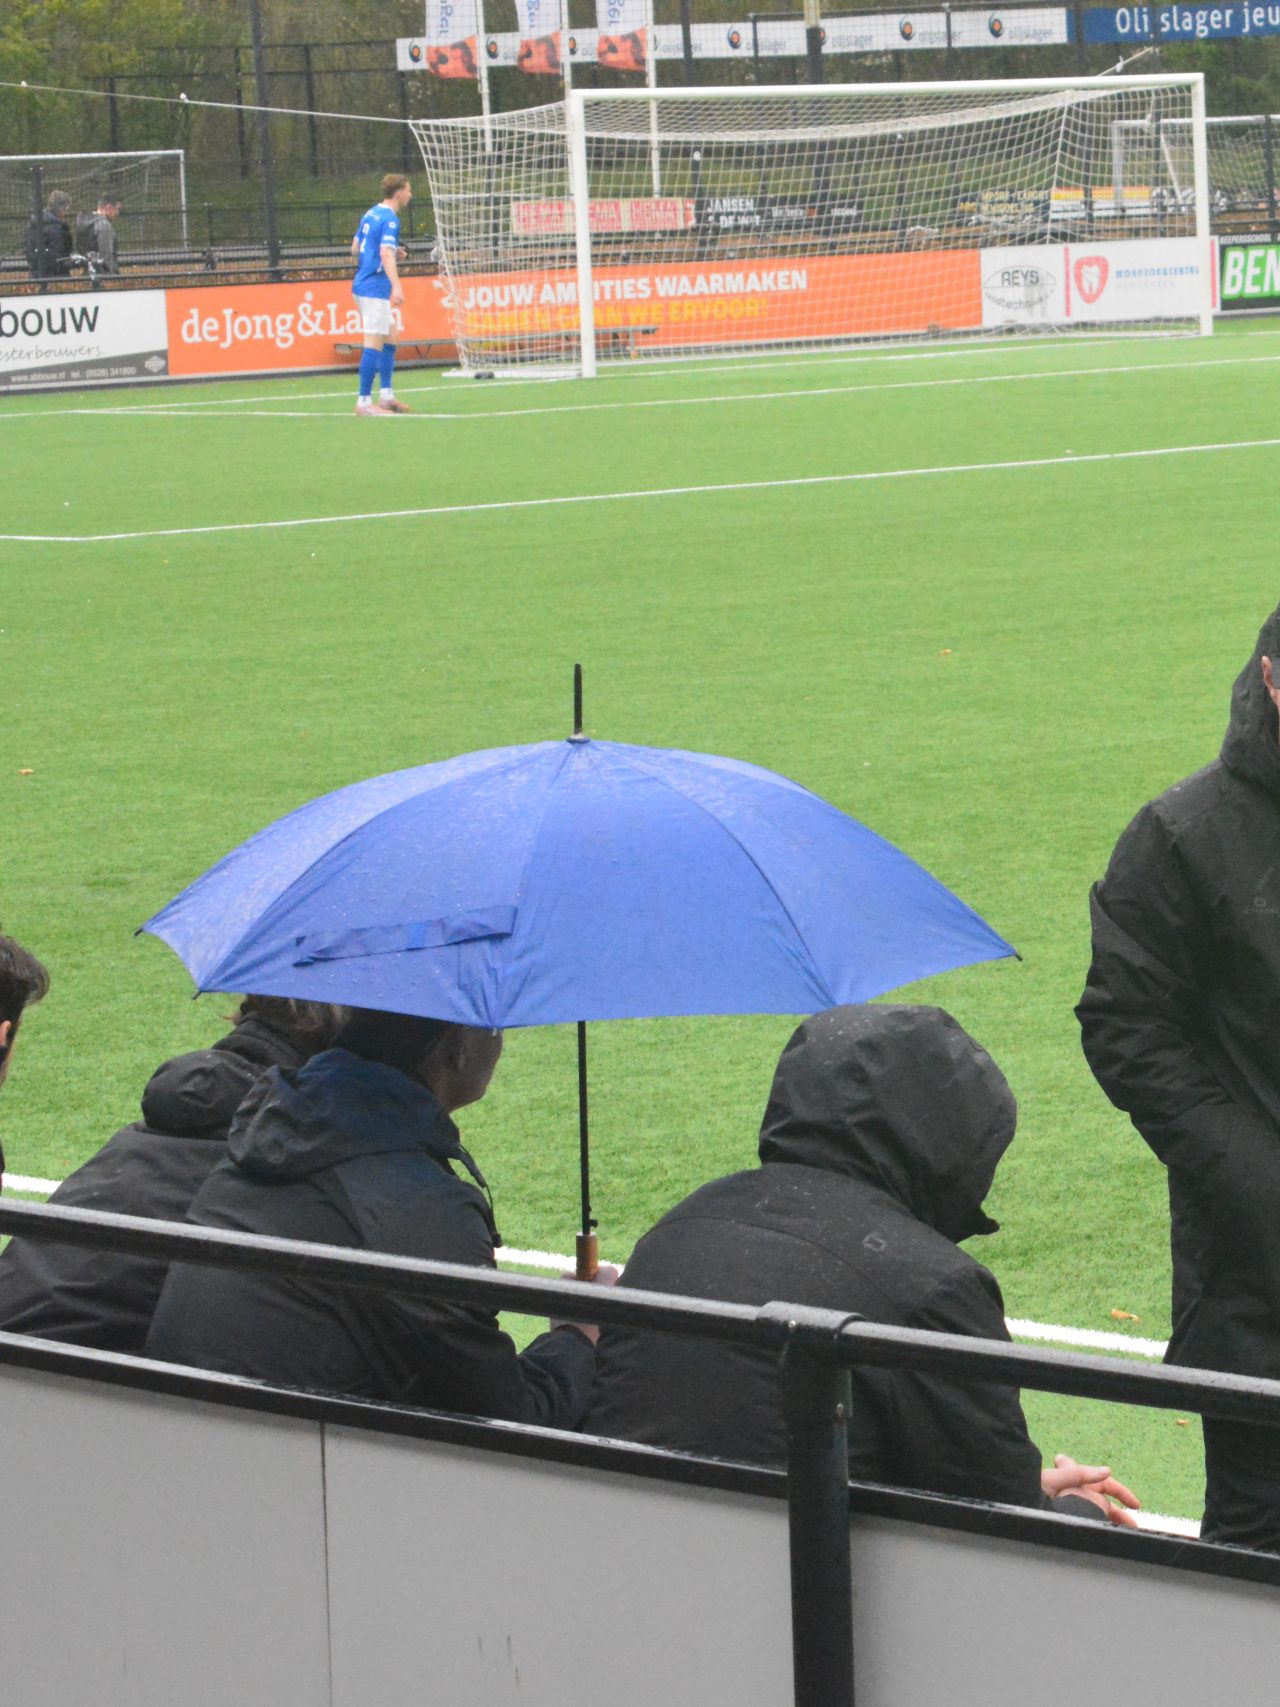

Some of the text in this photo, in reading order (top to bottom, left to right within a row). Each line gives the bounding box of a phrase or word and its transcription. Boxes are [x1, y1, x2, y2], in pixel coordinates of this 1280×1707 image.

[1115, 7, 1234, 36] Olislager
[464, 270, 808, 308] JOUW AMITIES WAARMAKEN
[1001, 270, 1040, 287] REYS
[629, 303, 664, 323] WE
[668, 297, 769, 321] ERVOOR!
